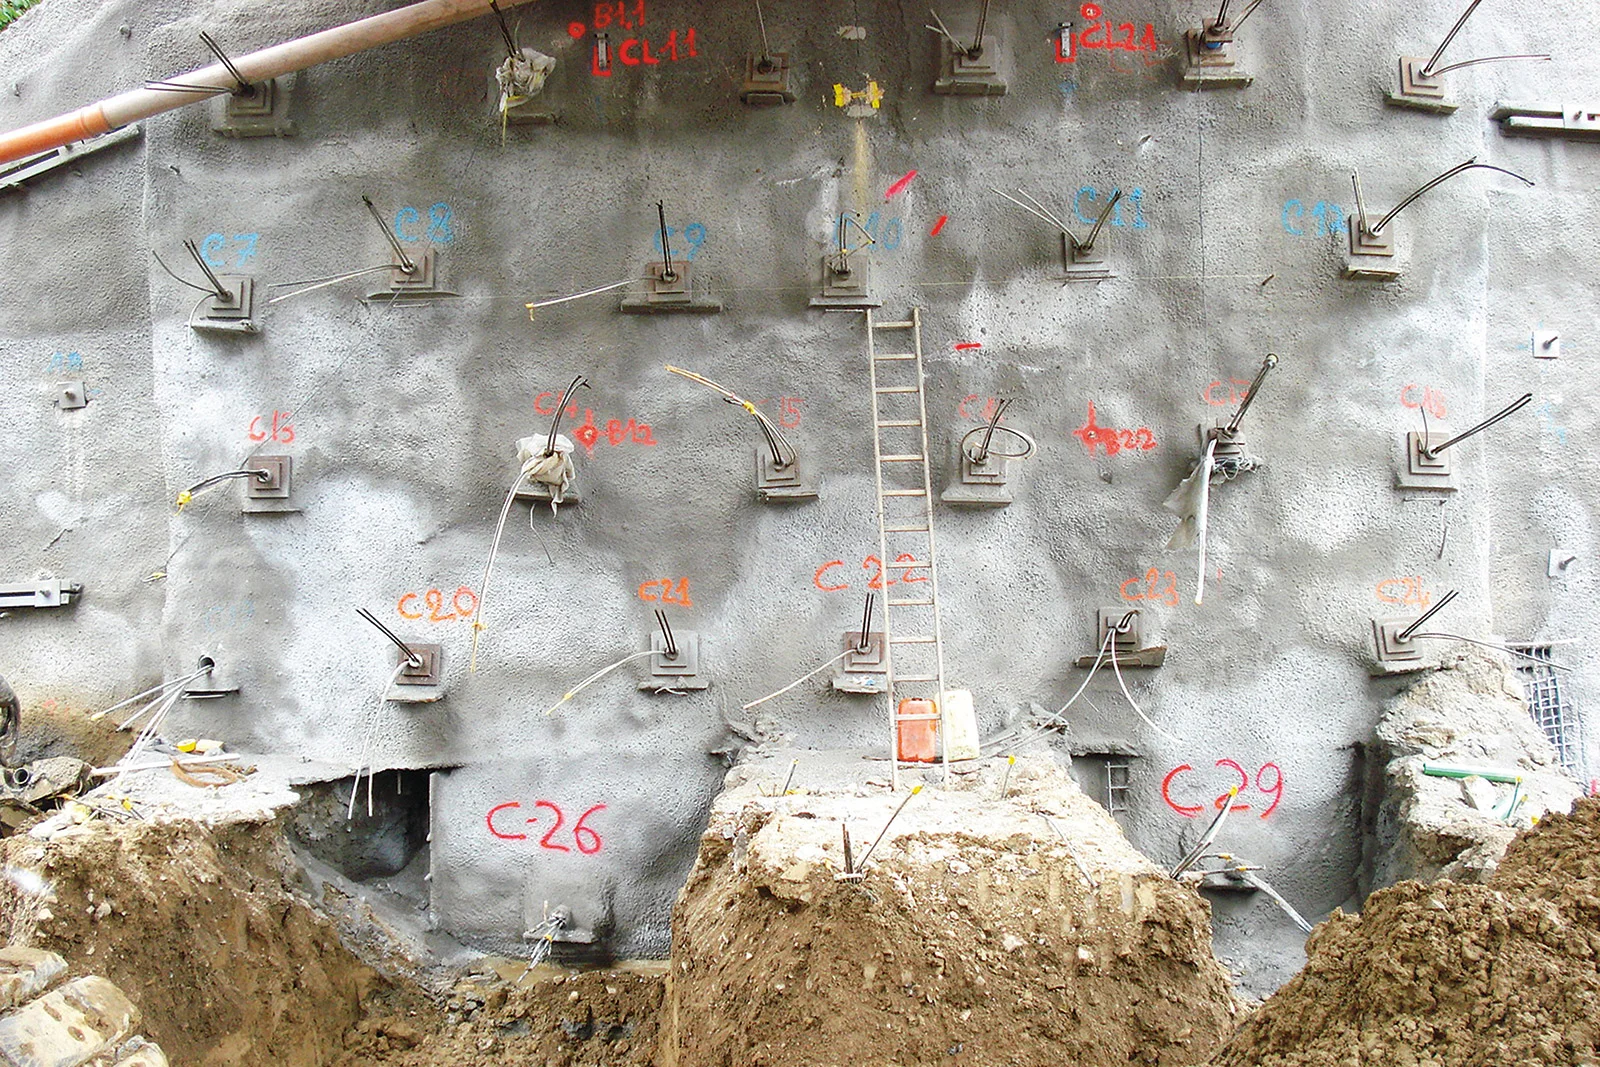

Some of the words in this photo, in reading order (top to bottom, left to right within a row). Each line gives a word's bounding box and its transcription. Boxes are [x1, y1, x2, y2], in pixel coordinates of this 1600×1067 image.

[200, 232, 258, 268] C7
[653, 222, 706, 261] C9
[606, 417, 658, 447] B12
[485, 799, 608, 855] C-26
